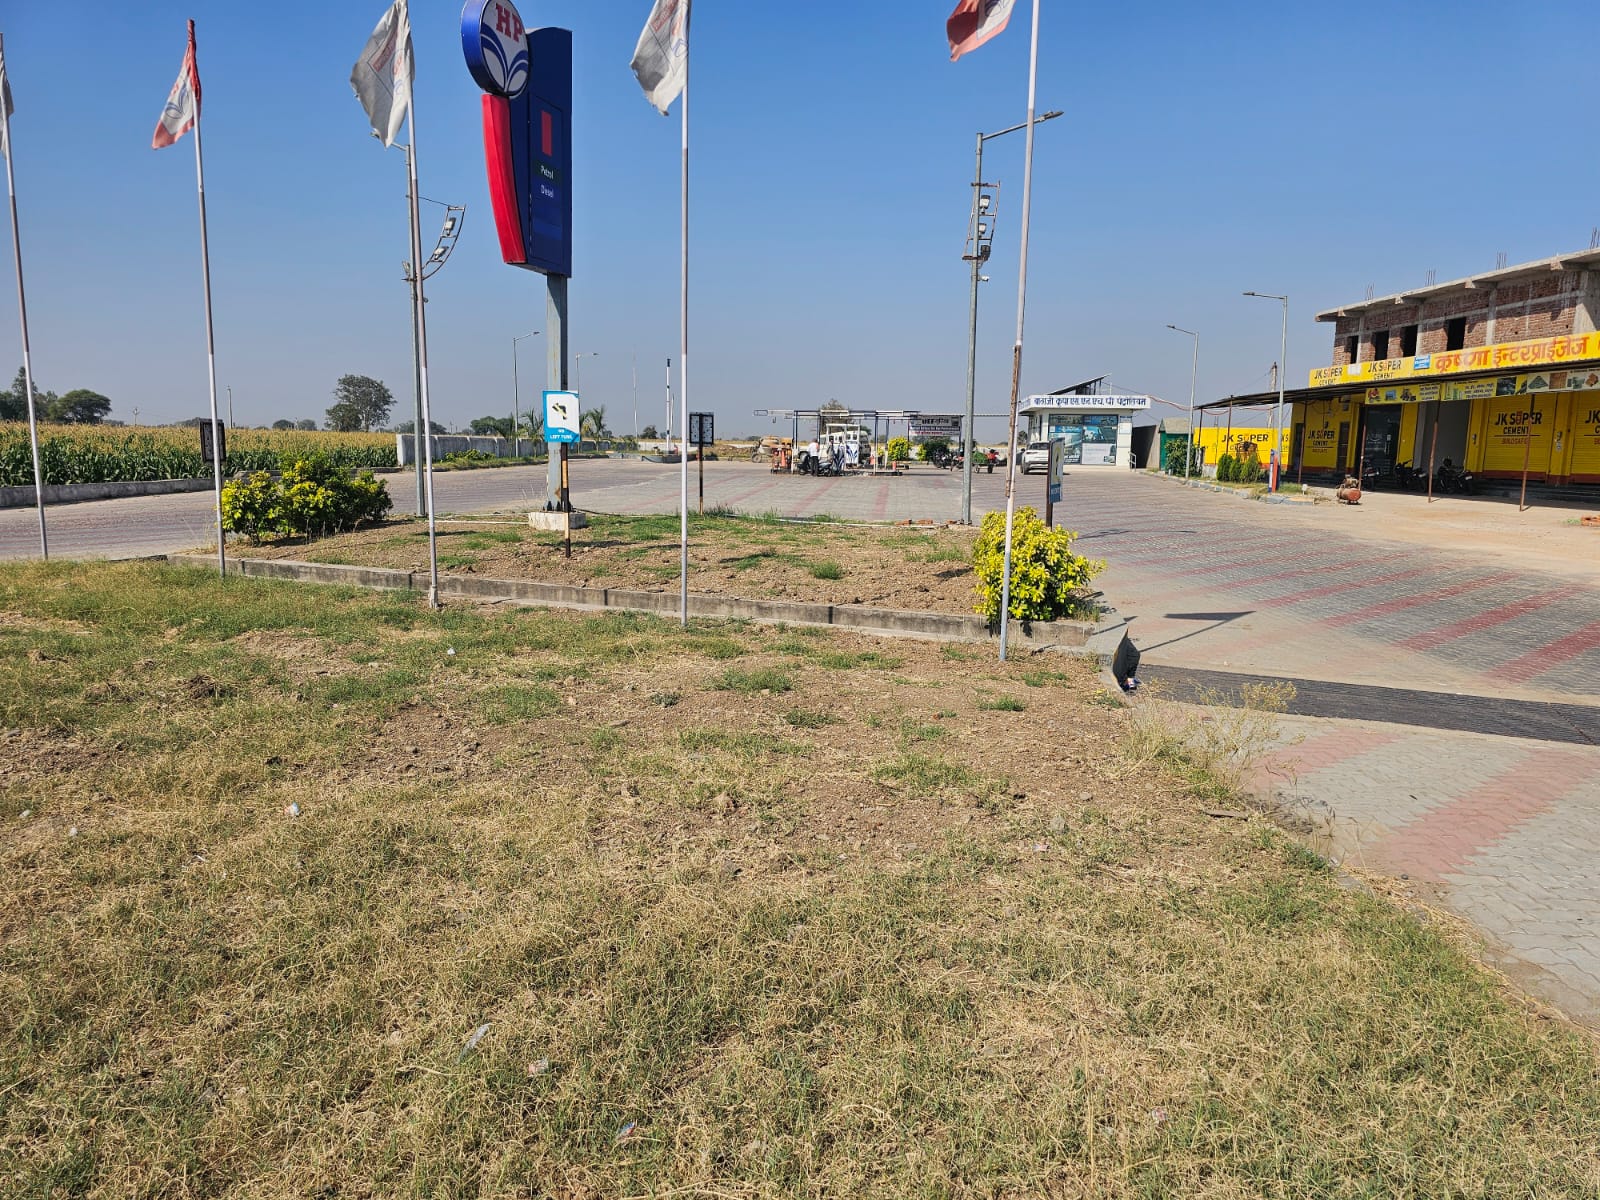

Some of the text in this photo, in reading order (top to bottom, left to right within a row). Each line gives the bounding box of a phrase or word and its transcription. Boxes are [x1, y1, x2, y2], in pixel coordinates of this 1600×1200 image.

[495, 2, 523, 43] HP
[1367, 361, 1377, 373] JK
[1378, 359, 1402, 371] SUPER
[1314, 367, 1343, 380] JK SUPER
[1495, 411, 1543, 426] JK SUPER
[1308, 429, 1335, 440] JK SUPER
[1503, 426, 1530, 435] CEMENT
[1221, 433, 1269, 443] JK SUPER
